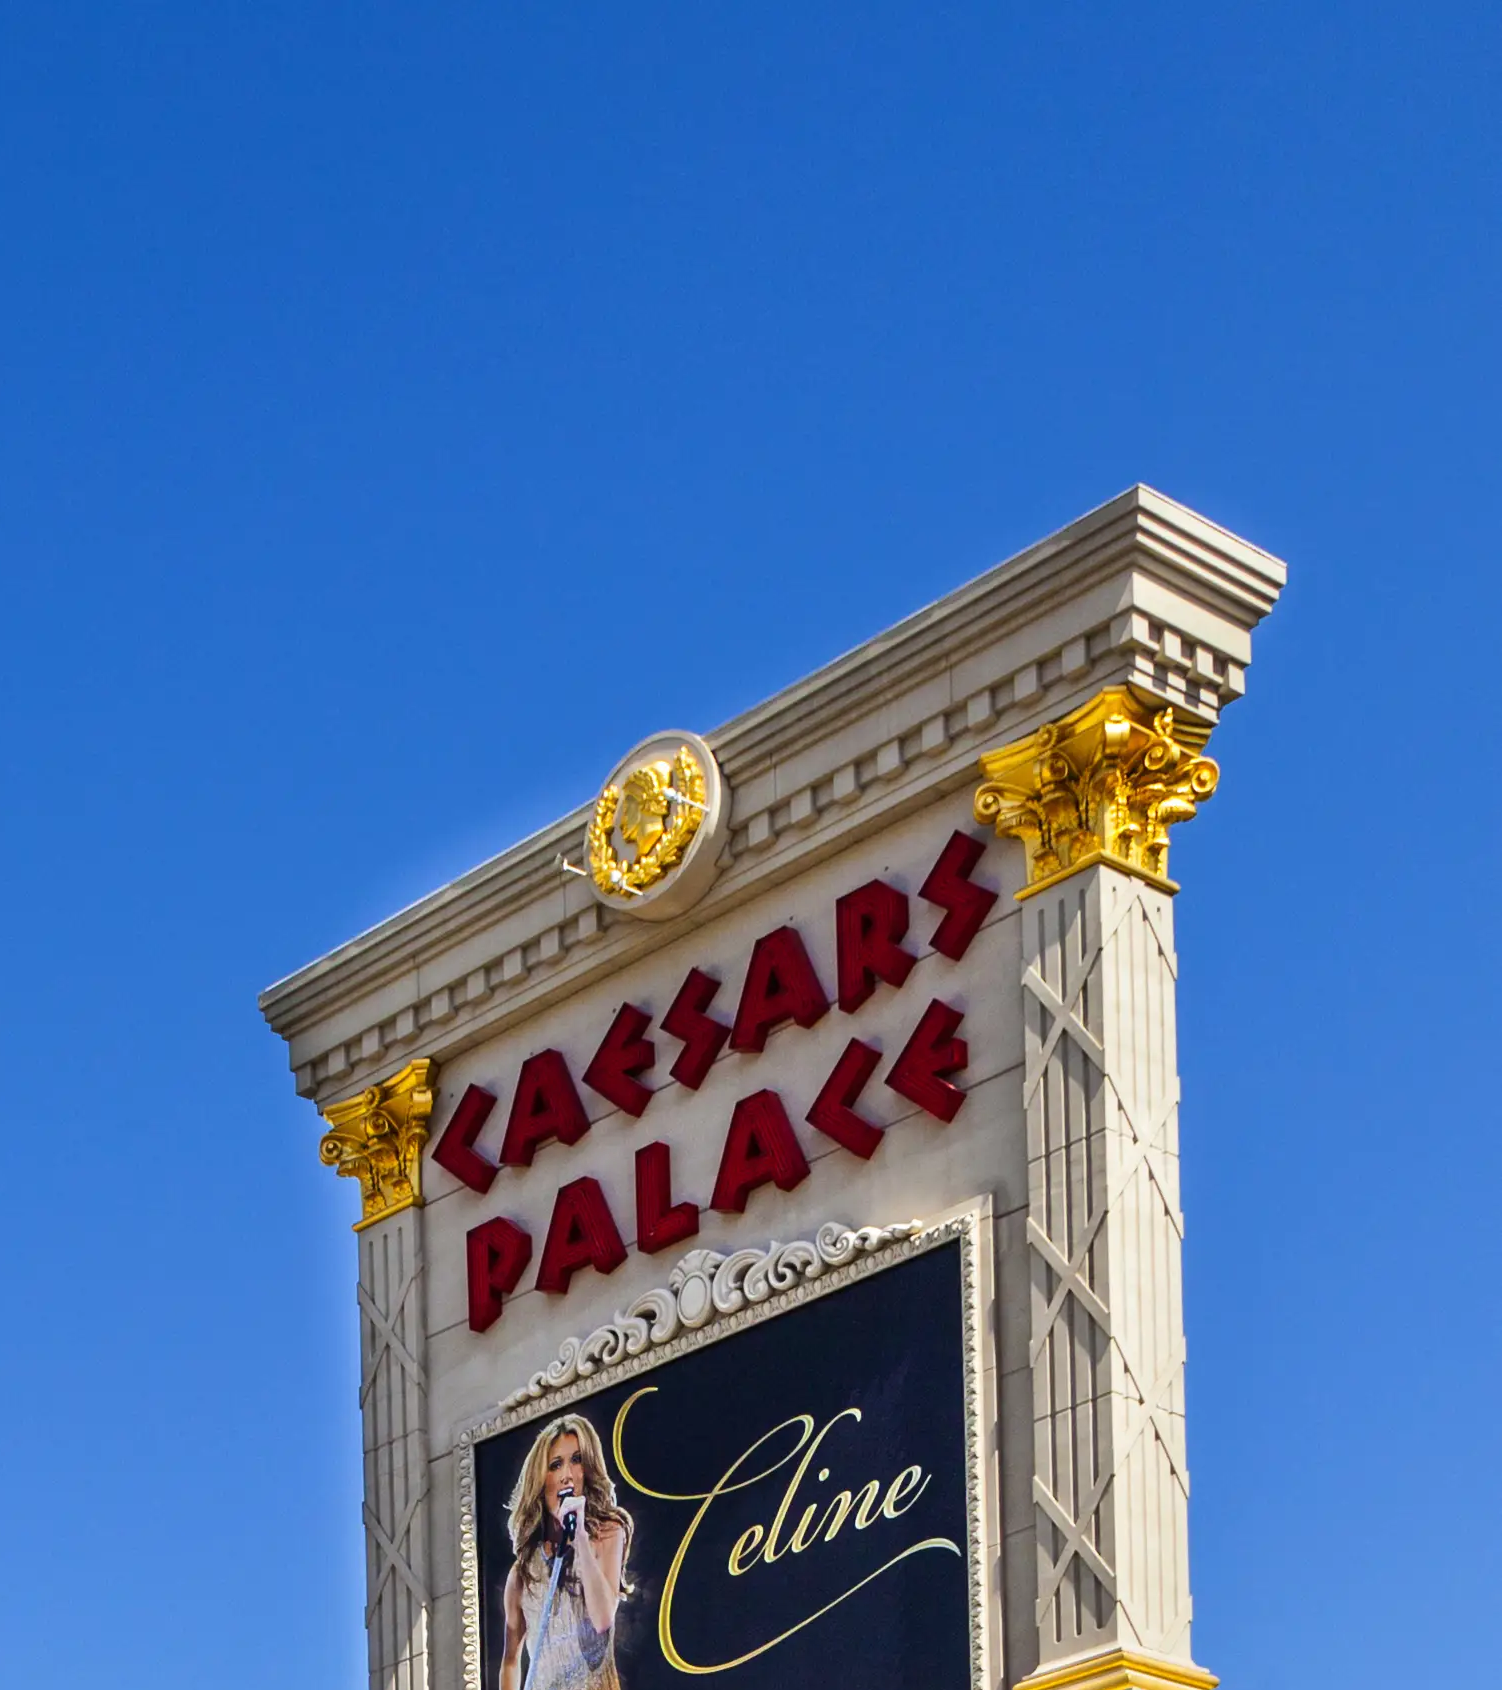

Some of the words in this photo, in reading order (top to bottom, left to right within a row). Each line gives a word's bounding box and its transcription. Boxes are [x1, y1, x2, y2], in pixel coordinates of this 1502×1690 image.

[432, 829, 998, 1194] CAESARS
[466, 998, 968, 1333] PALACE
[613, 1386, 962, 1675] Celine
